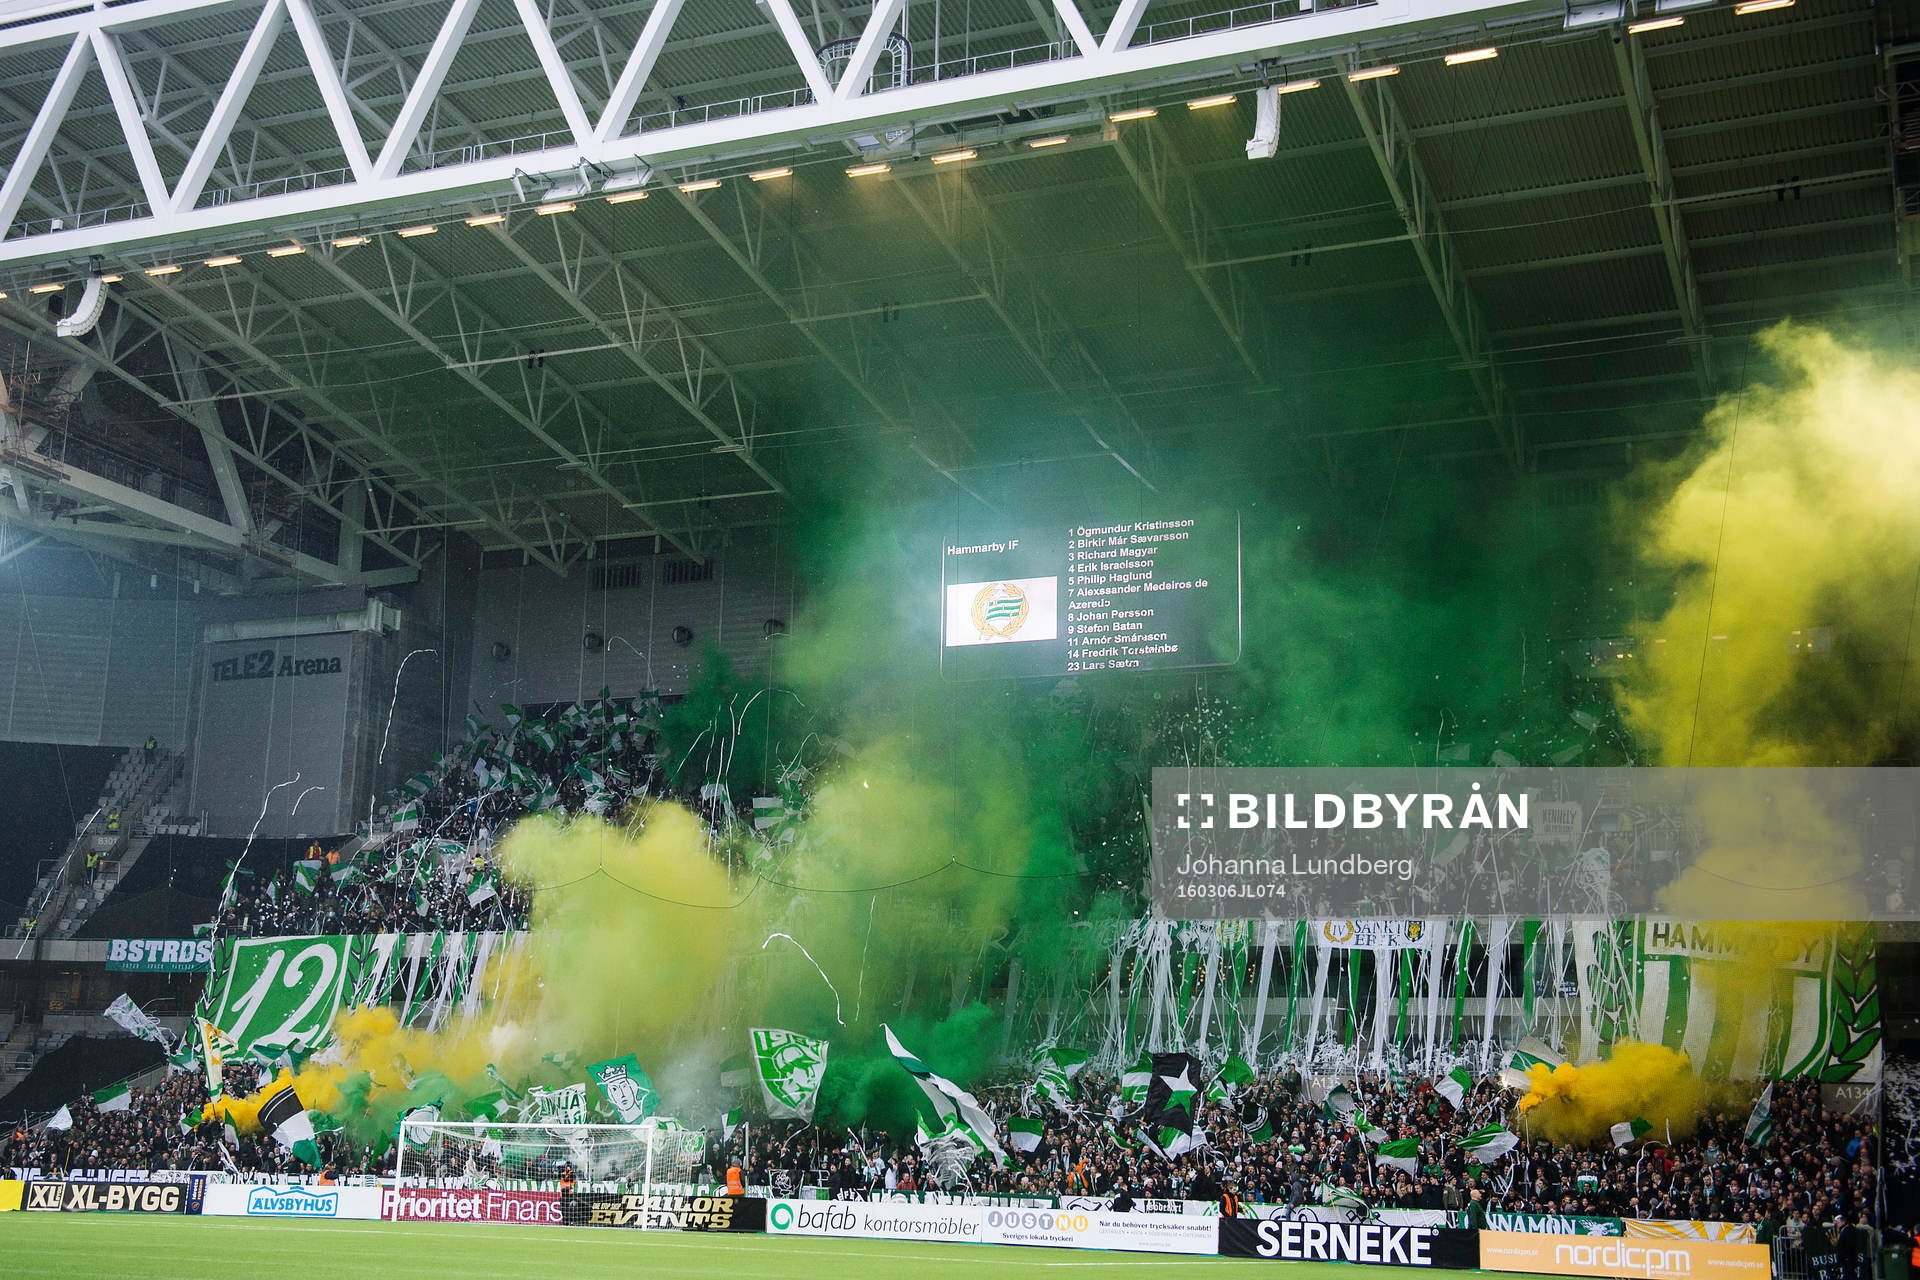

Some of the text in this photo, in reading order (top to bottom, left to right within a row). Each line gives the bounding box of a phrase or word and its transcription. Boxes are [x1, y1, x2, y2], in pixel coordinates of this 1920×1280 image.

[1068, 519, 1195, 537] 1 Ögmundur Kristinsson
[947, 540, 1020, 557] Hammarby IF
[1068, 531, 1189, 549] 2 Birkir Már Sævarsson
[1068, 546, 1159, 561] 3 Richard Magyar
[1068, 558, 1154, 573] 4 Erik Israelsson
[1068, 571, 1153, 586] 5 Philip Haglund
[1068, 578, 1208, 598] 7 Alexssander Medeiros de
[1067, 608, 1155, 622] 8 Johan Persson
[1067, 621, 1143, 635] 9 Stefan Batan
[1067, 637, 1079, 647] 11
[1081, 635, 1112, 646] Arnór
[1067, 649, 1080, 659] 14
[1081, 647, 1119, 658] Fredrik
[212, 649, 342, 682] TELE2 Arena
[1067, 662, 1080, 672] 23
[1081, 660, 1106, 671] Lars
[1354, 934, 1401, 947] ERK
[110, 938, 212, 964] BSTRDS
[228, 943, 339, 1053] 12
[29, 1185, 58, 1209] XL
[67, 1184, 180, 1212] XL-BYGG
[252, 1197, 333, 1212] ÄLVSBYHUS
[383, 1190, 563, 1222] Prioritet Finans
[588, 1209, 733, 1229] EVENTS
[797, 1203, 979, 1236] bafab kontorsmöbler
[1111, 1220, 1120, 1228] du
[1150, 1222, 1185, 1232] trycksaker
[1186, 1223, 1212, 1232] snabbt!
[1002, 1232, 1074, 1244] Sveriges lokala tryckeri
[1256, 1220, 1432, 1266] SERNEKE
